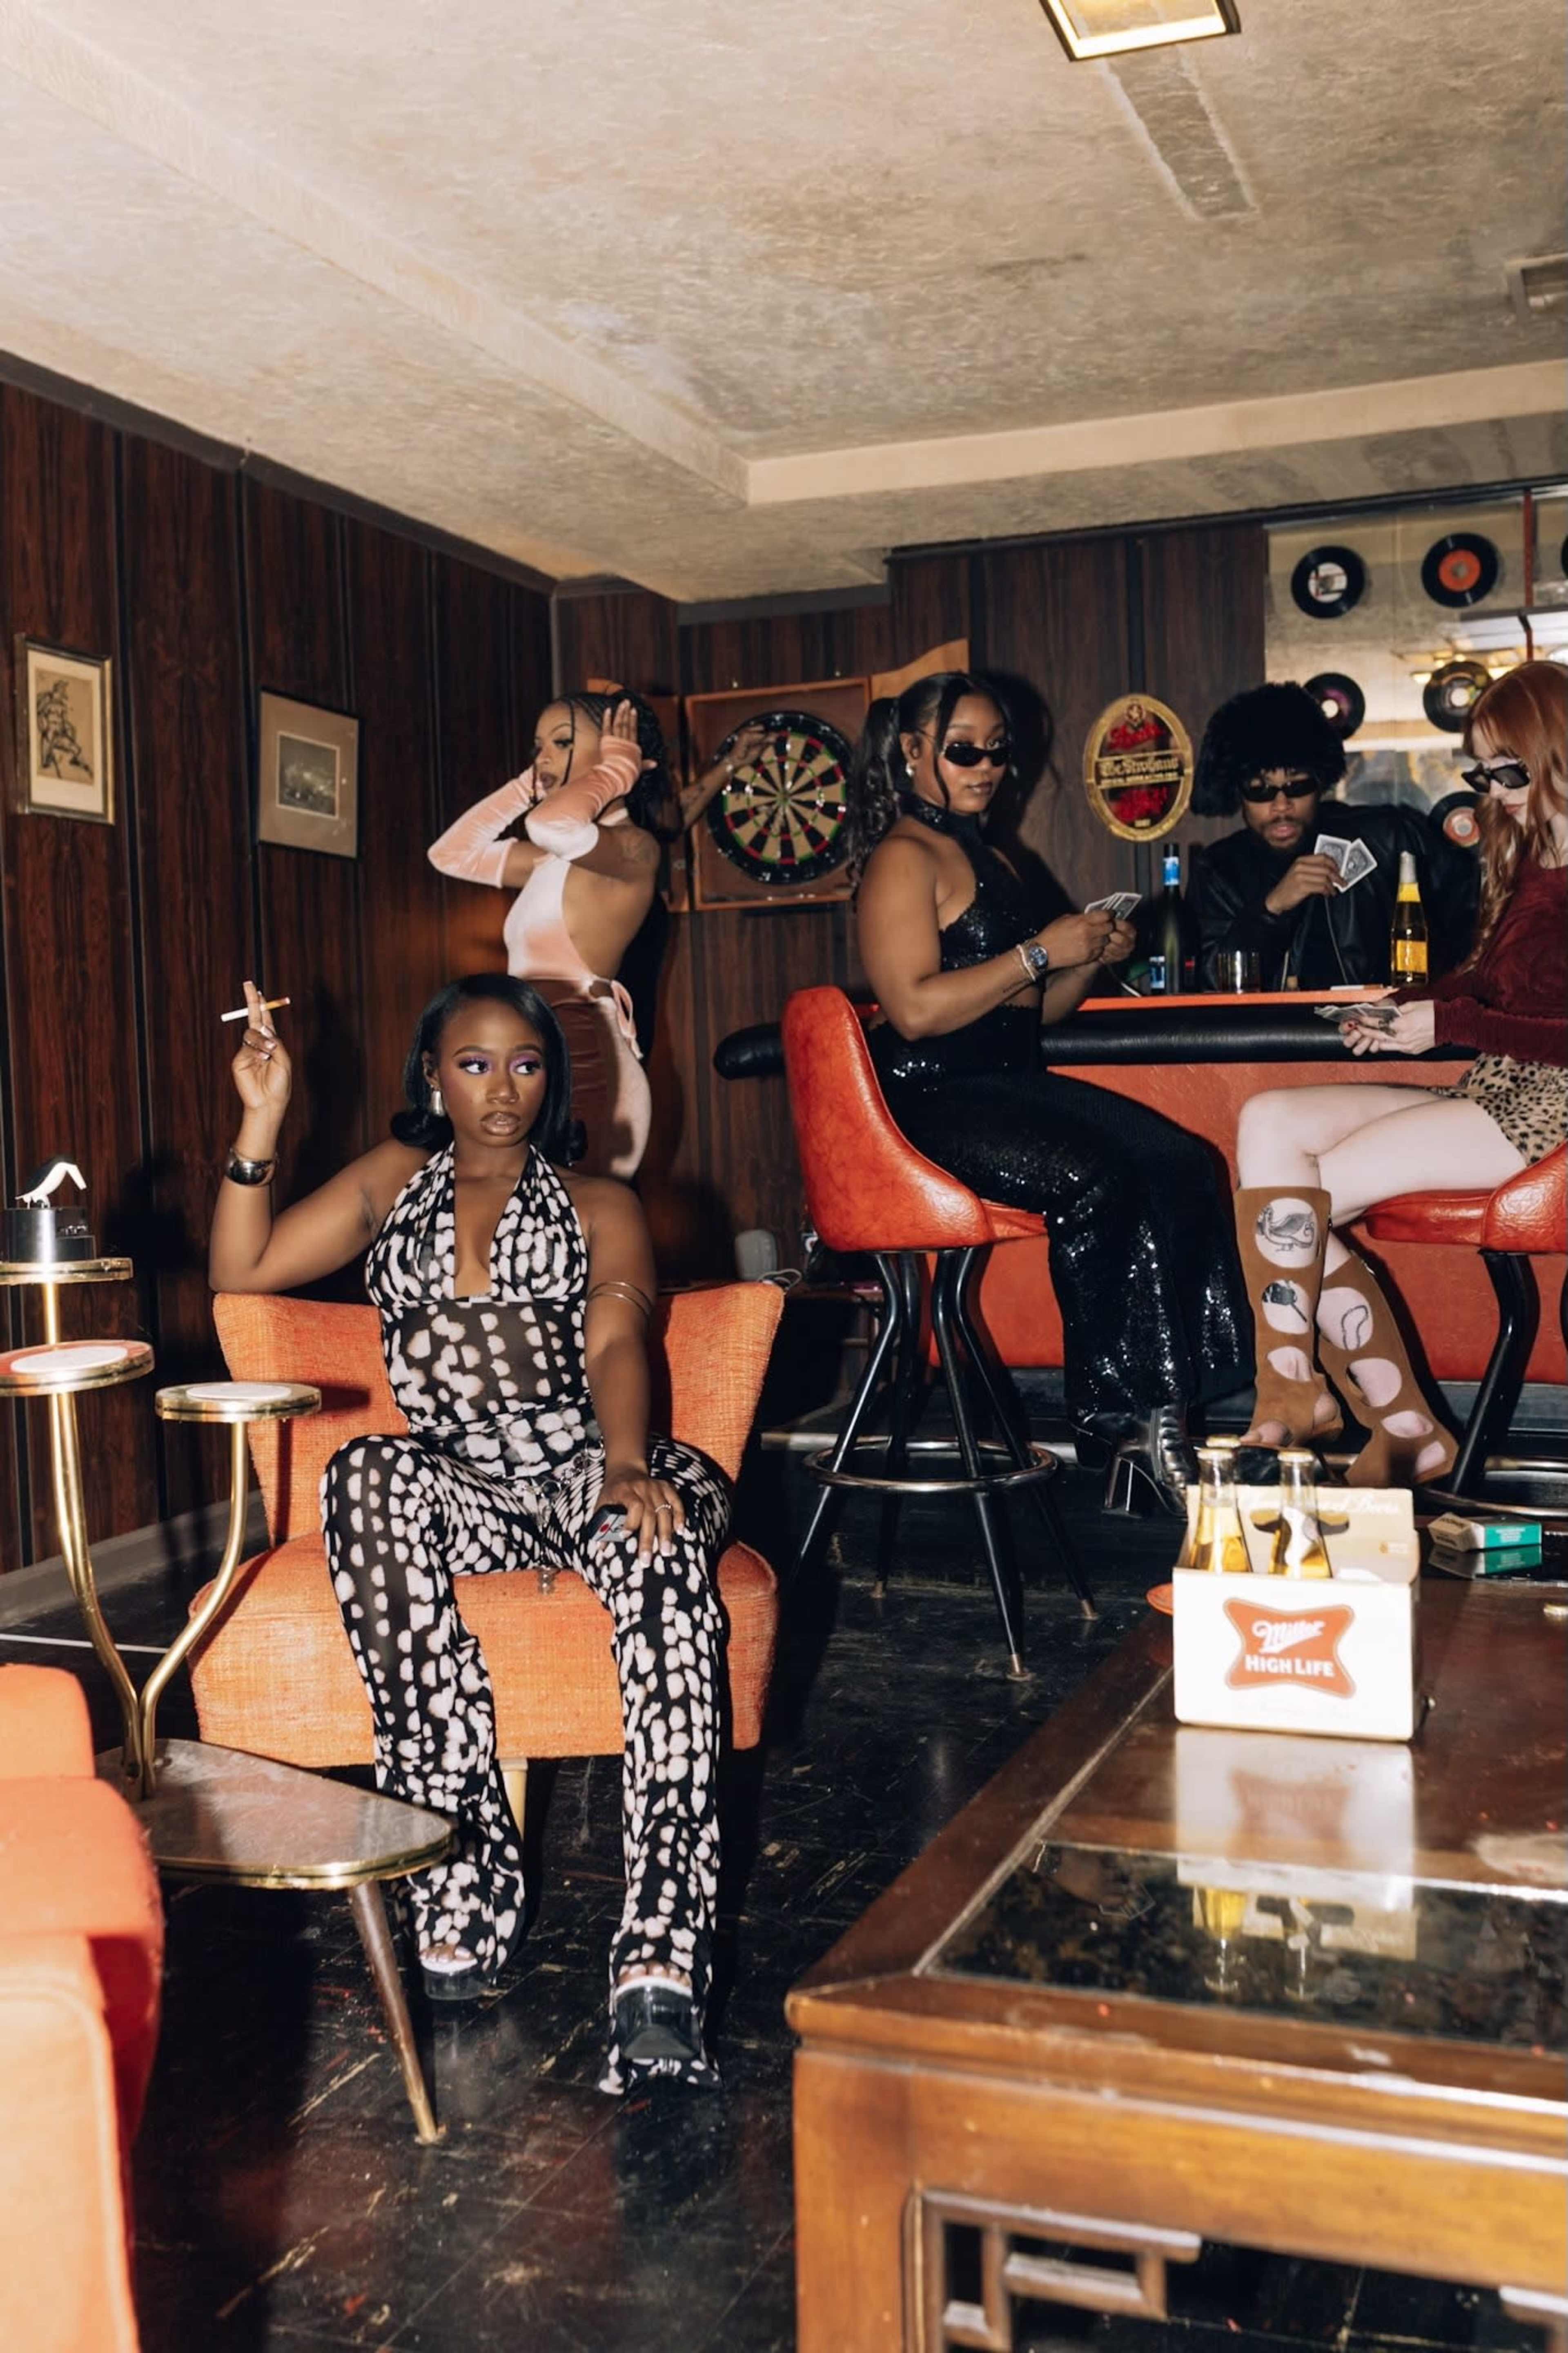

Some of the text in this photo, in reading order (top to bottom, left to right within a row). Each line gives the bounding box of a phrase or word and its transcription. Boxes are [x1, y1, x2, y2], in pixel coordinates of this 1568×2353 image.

[1252, 1620, 1325, 1654] Miller
[1245, 1654, 1335, 1677] HIGH LIFE
